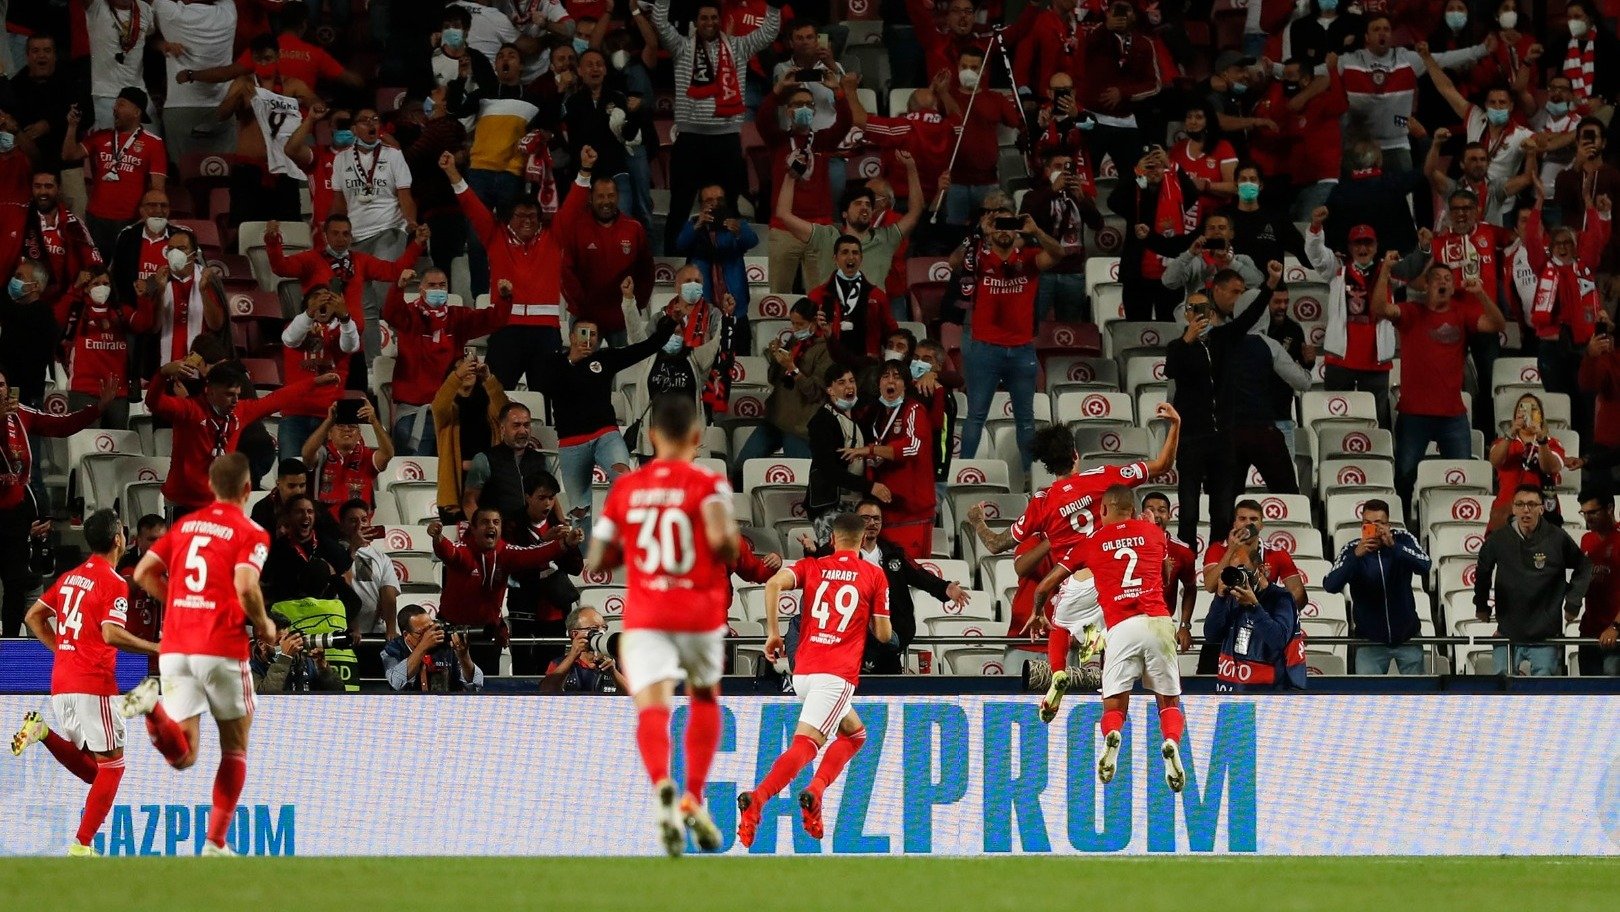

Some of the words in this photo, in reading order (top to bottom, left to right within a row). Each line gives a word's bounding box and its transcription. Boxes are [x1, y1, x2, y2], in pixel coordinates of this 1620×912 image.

[100, 151, 142, 166] Emates
[346, 177, 387, 188] Emtes
[984, 275, 1029, 287] Emirates
[1059, 494, 1093, 518] DARWIN
[1070, 508, 1095, 538] 9
[625, 506, 696, 575] 30
[1102, 536, 1145, 552] GILBERTO
[185, 535, 212, 593] 5
[821, 569, 859, 582] TAARABT
[1113, 547, 1143, 588] 2
[59, 586, 86, 641] 34
[811, 580, 860, 633] 49
[670, 702, 1257, 853] GAZPROM
